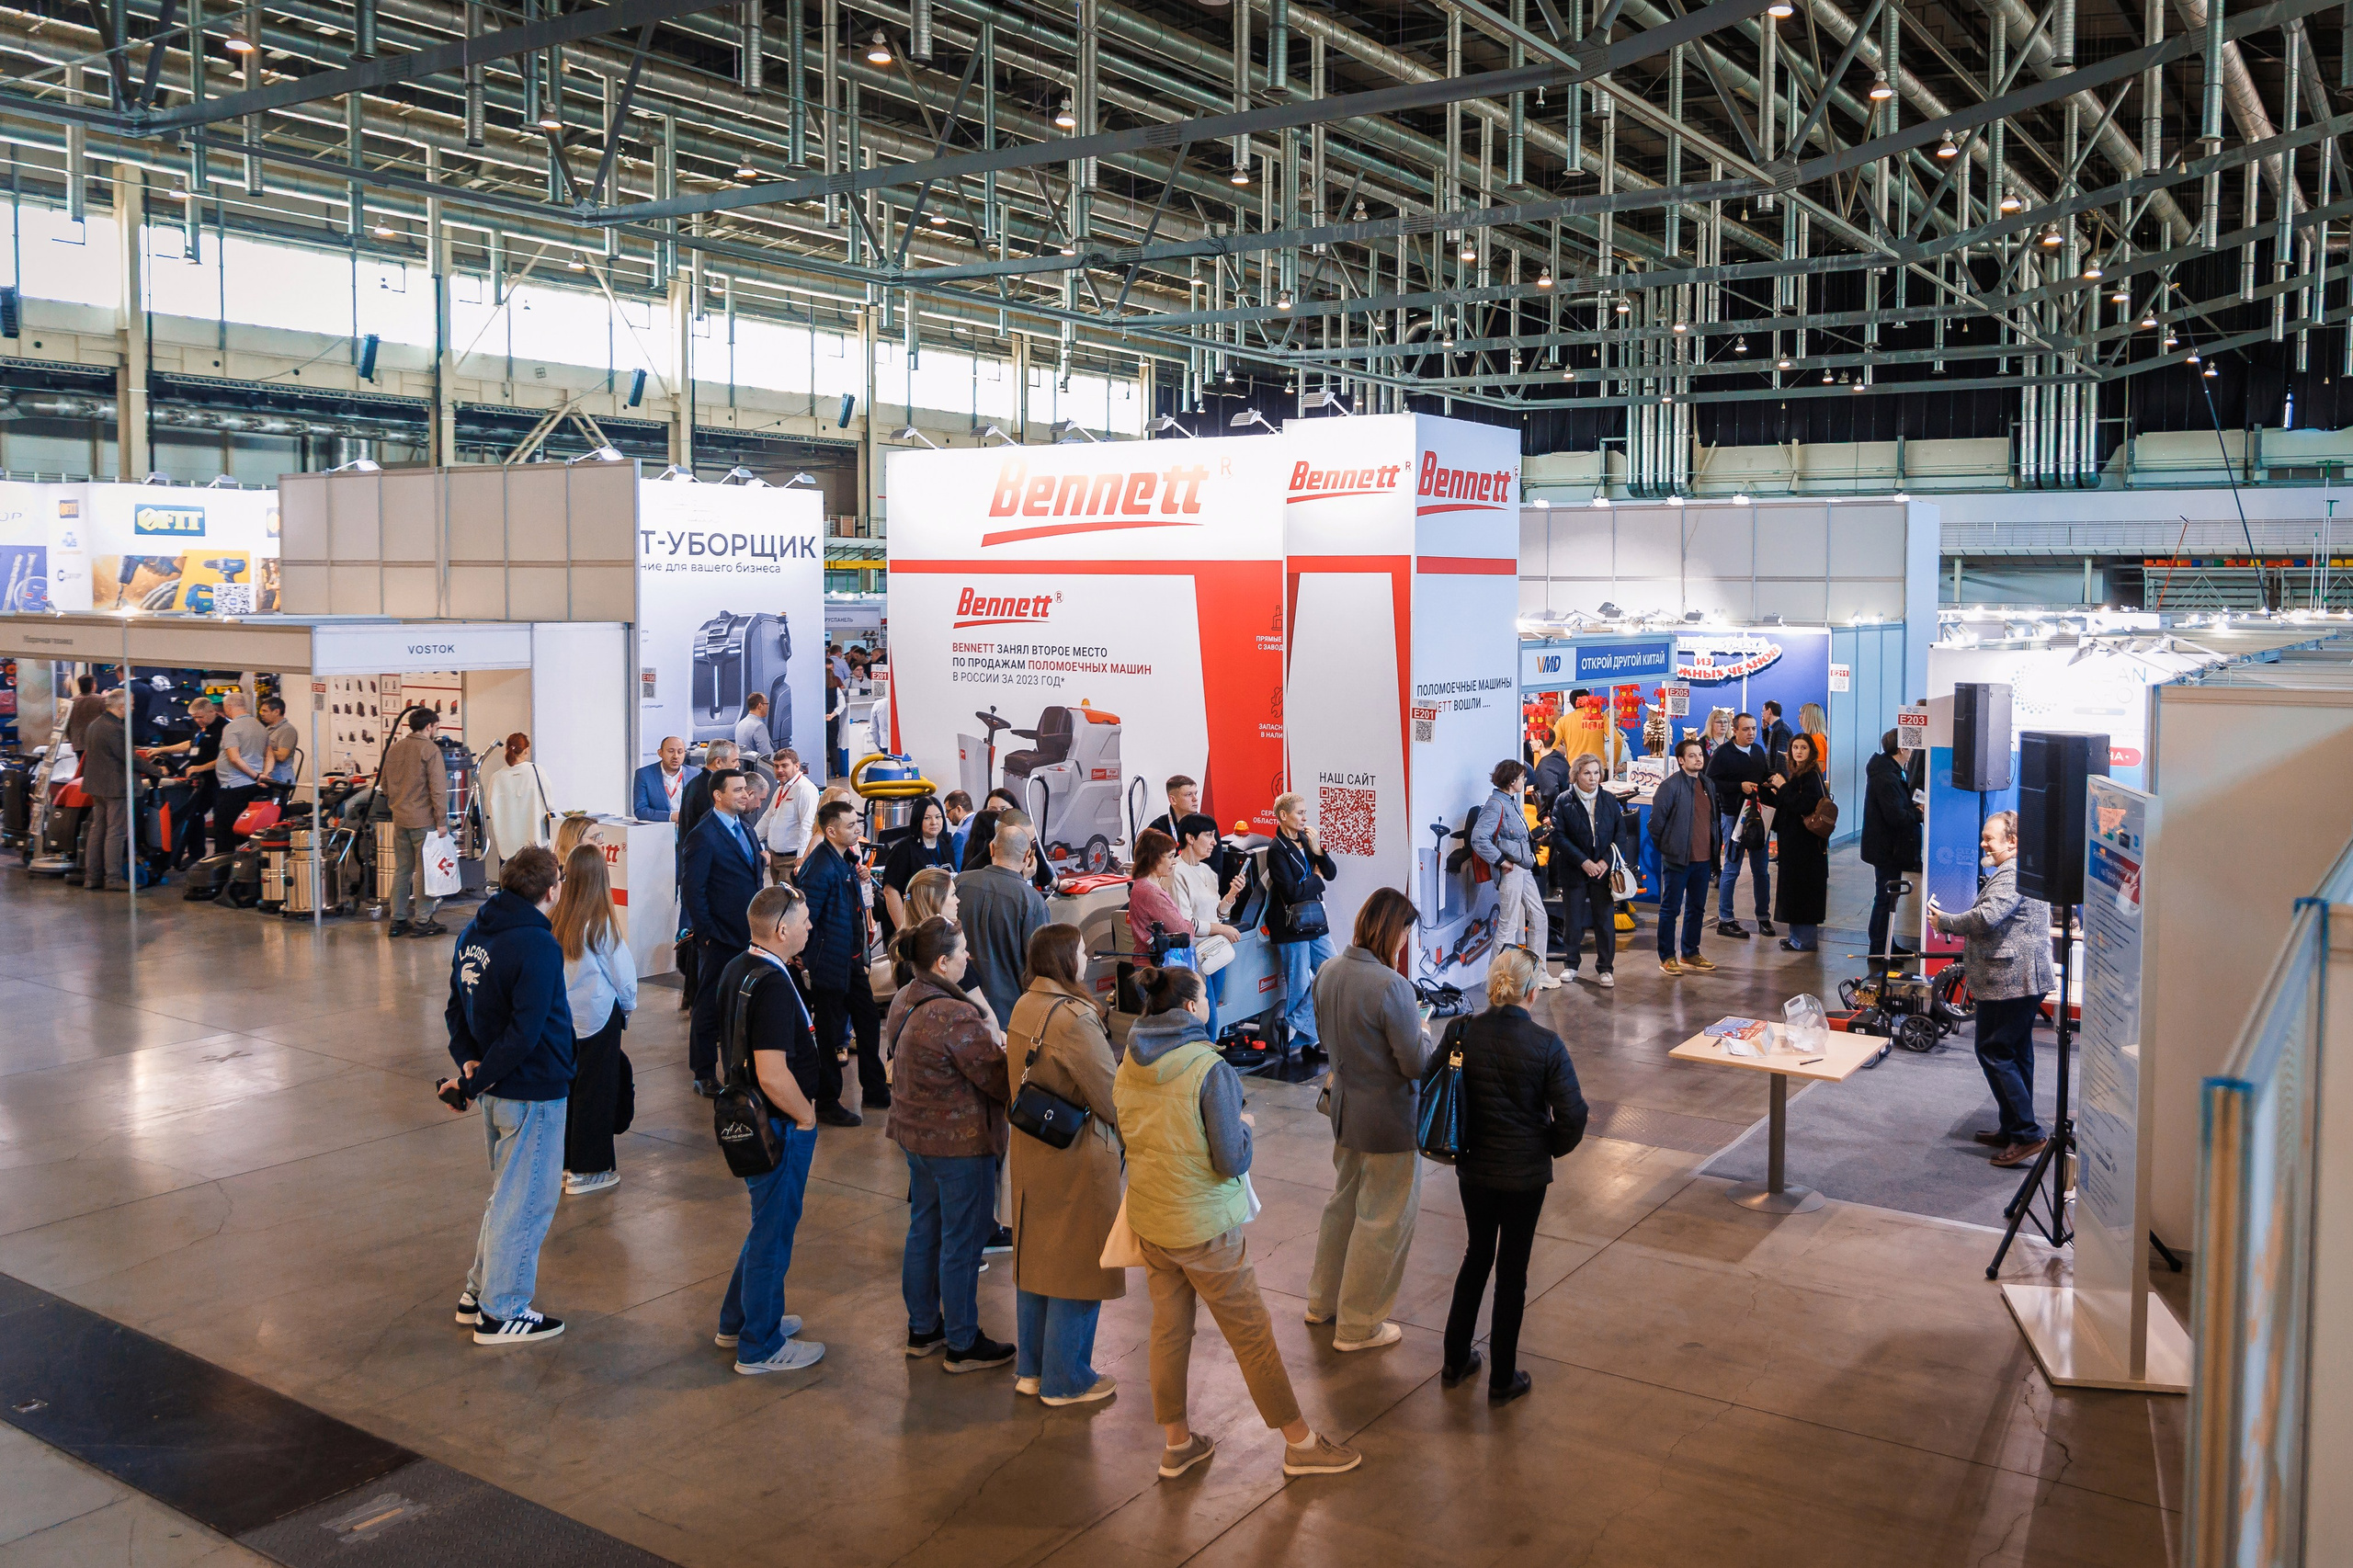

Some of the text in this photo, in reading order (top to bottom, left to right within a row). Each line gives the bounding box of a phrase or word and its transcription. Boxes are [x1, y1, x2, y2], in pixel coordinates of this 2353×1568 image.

[1289, 460, 1400, 490] Bennett
[1417, 450, 1511, 503] Bennett
[989, 458, 1210, 517] Bennett
[641, 530, 816, 562] Т-УБОРЩИК
[666, 563, 687, 573] для
[691, 563, 733, 573] вашего
[735, 562, 781, 574] бизнеса
[956, 587, 1052, 617] Bennett
[407, 644, 455, 654] VOSTOK
[952, 642, 1108, 657] BENNETT ЗАНЯЛ ВТОРОЕ МЕСТО
[952, 657, 1152, 675] ПО ПРОДАЖАМ ПОЛОМОЕЧНЫХ МАШИН
[1537, 655, 1561, 673] VMD
[1581, 651, 1665, 670] ОТКРОЙ ДРУГОЙ КИТАЙ
[1697, 658, 1711, 666] ИЗ
[953, 672, 959, 682] В
[961, 672, 999, 684] РОССИИ
[1002, 674, 1014, 685] ЗА
[1017, 675, 1039, 686] 2023
[1417, 677, 1512, 697] ПОЛОМОЕЧНЫЕ МАШИНЫ
[1670, 688, 1688, 697] E205
[1454, 698, 1481, 711] ВОШЛИ
[1415, 709, 1434, 719] E201
[1900, 715, 1925, 724] E203
[1258, 722, 1282, 731] ЗАПАСН
[1319, 772, 1376, 786] НАШ САЙТ
[459, 945, 491, 970] LACOSTE
